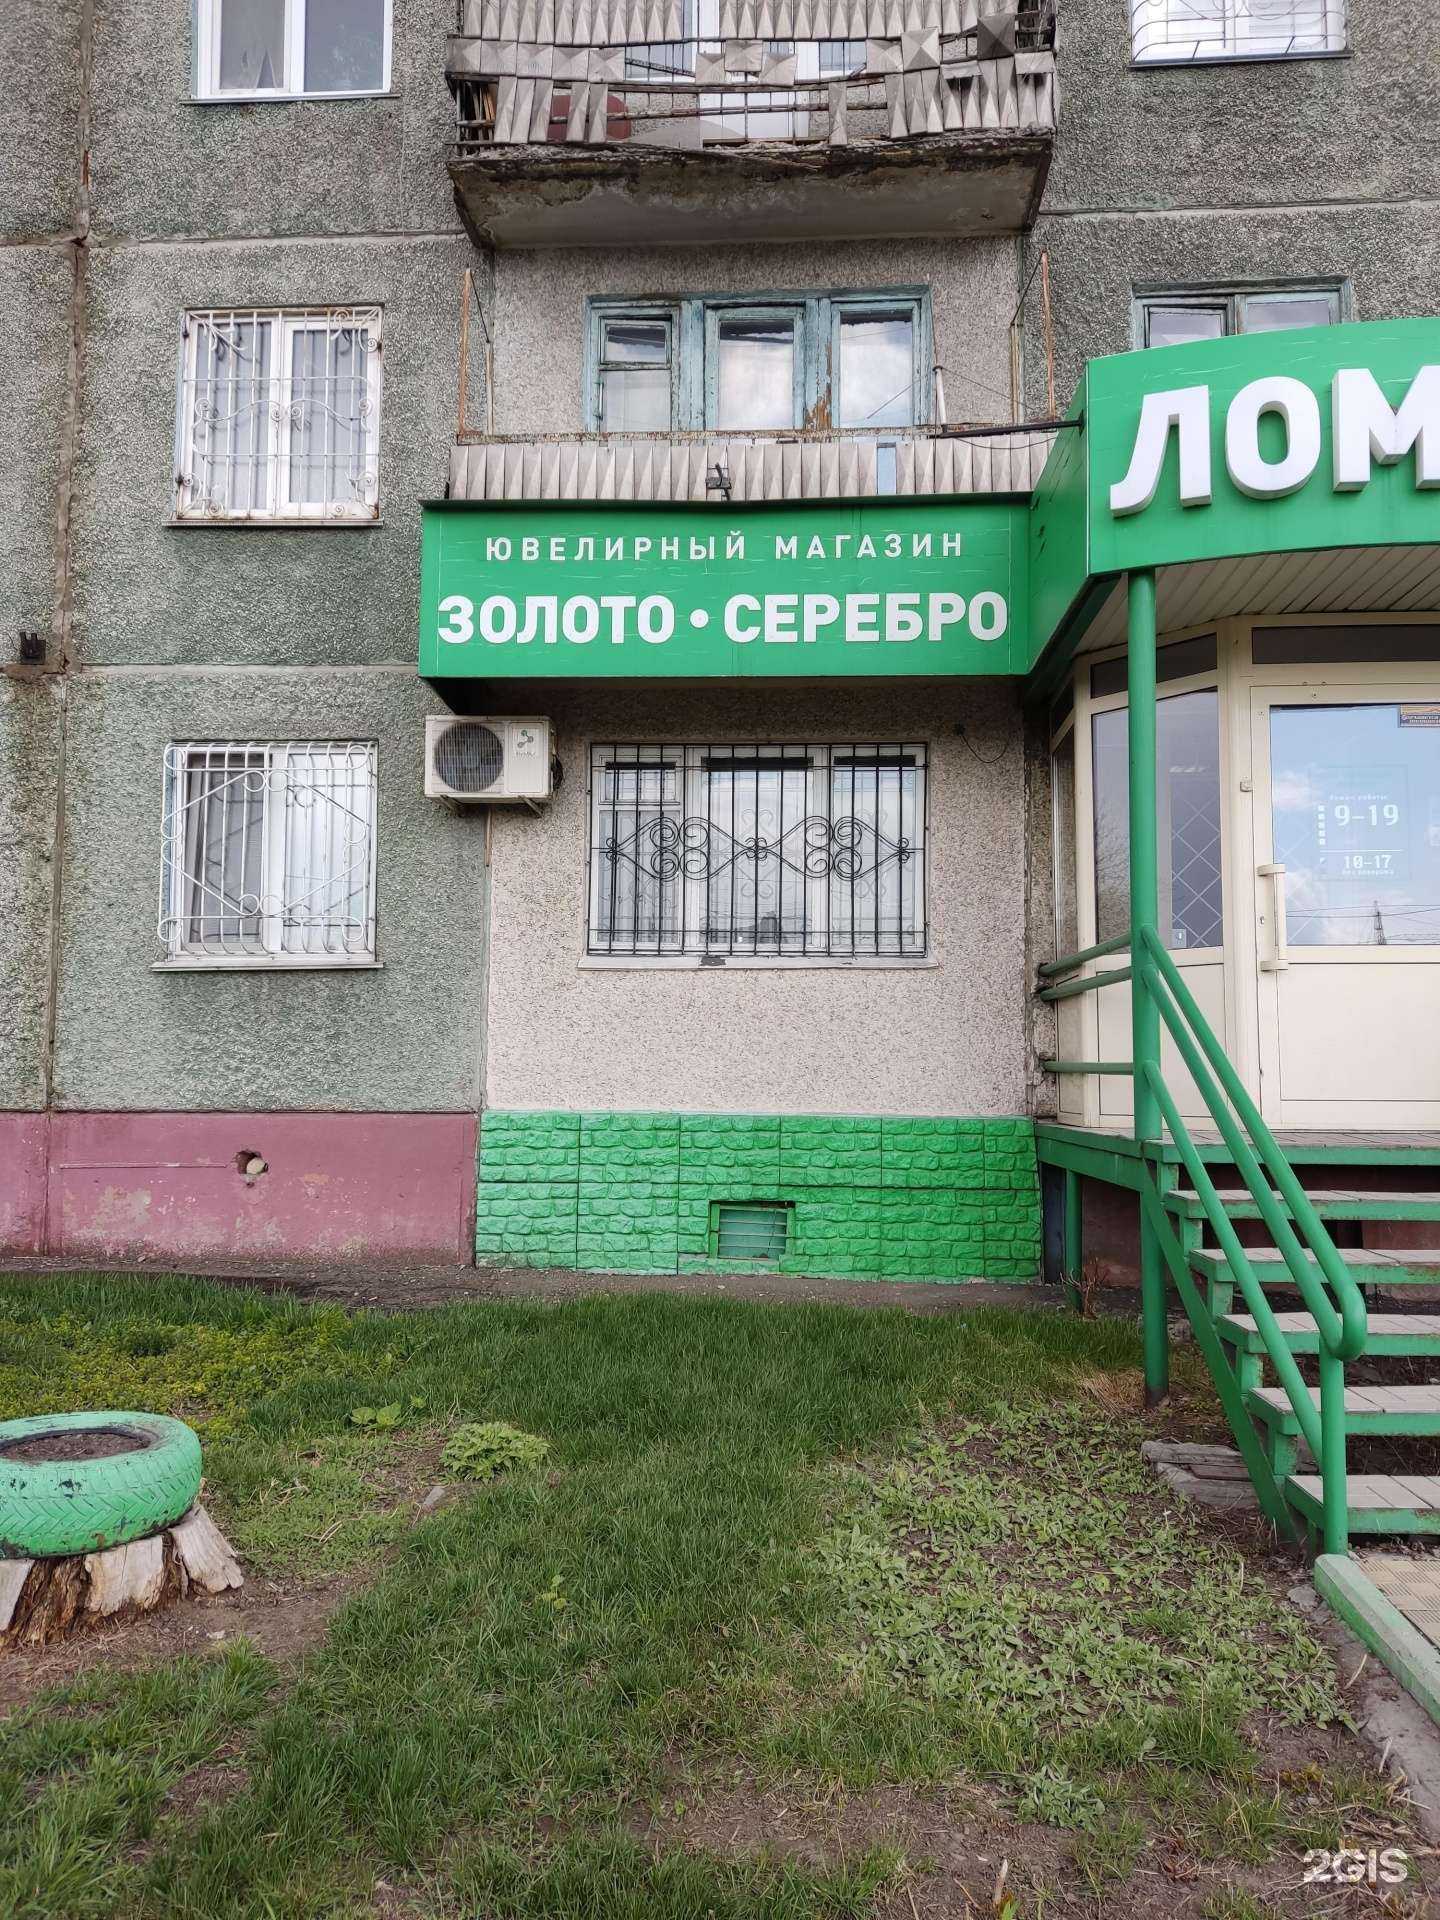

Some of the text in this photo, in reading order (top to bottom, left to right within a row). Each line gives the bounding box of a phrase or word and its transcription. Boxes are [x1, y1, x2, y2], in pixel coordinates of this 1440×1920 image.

[1110, 365, 1440, 519] ЛОМ
[486, 530, 962, 561] ЮВЕЛИРНЫЙ МАГАЗИН
[438, 591, 1008, 645] ЗОЛОТО СЕРЕБРО
